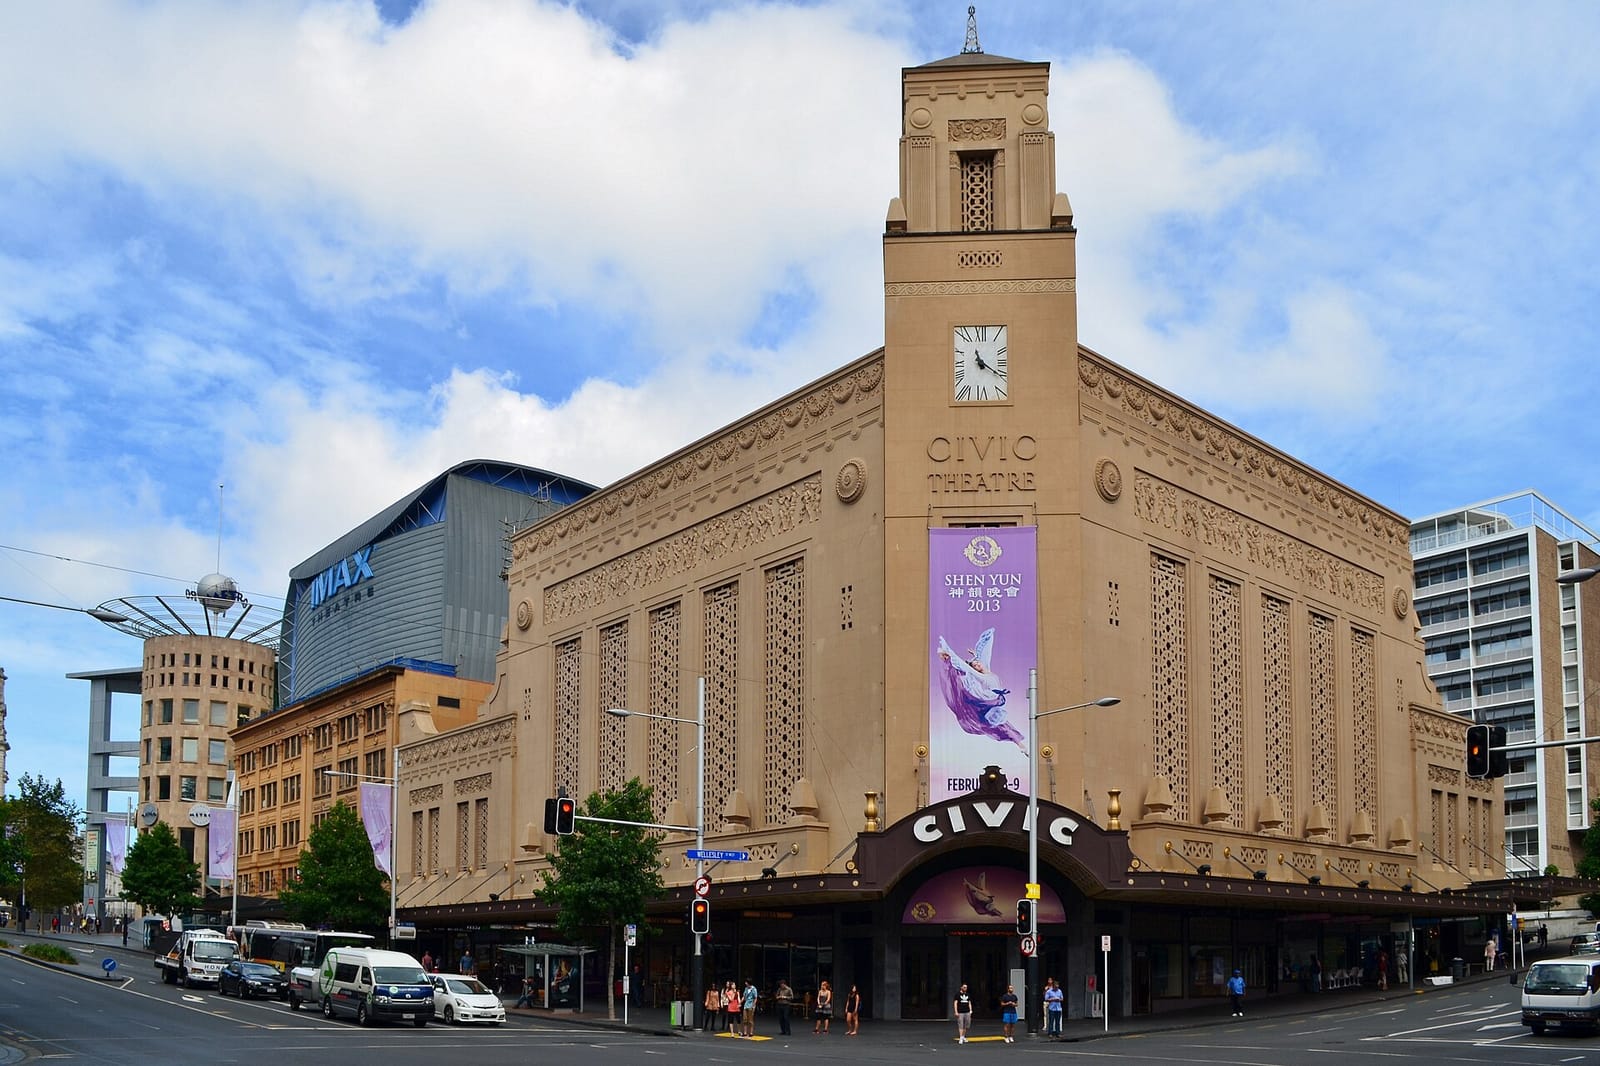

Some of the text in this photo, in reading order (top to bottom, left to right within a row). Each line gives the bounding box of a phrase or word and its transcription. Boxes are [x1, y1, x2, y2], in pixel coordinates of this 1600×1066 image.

[927, 435, 1037, 463] CIVIC
[927, 472, 1037, 493] THEATRE
[311, 545, 374, 610] IMAX
[944, 573, 1022, 587] SHEN YUN
[948, 586, 1020, 598] 神韻晚會
[967, 599, 1001, 612] 2013
[697, 851, 723, 859] WELLESLEY
